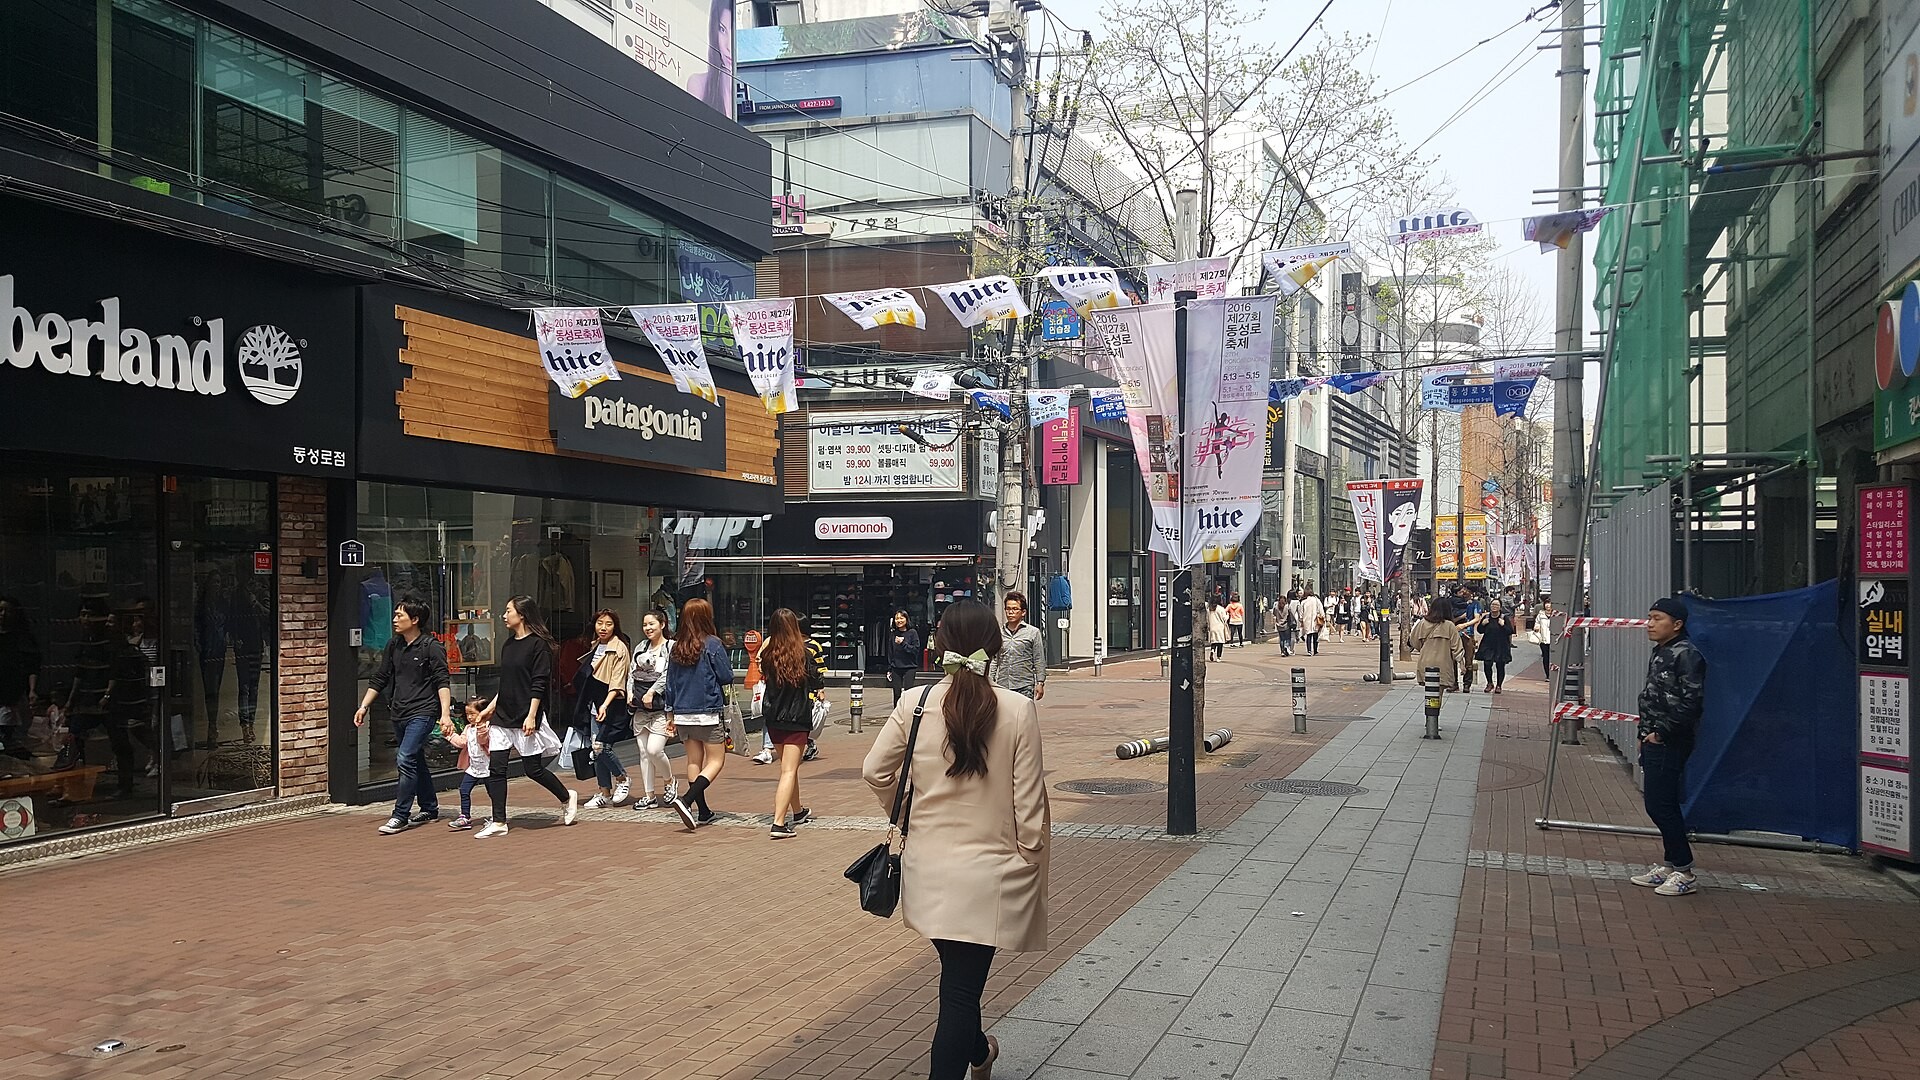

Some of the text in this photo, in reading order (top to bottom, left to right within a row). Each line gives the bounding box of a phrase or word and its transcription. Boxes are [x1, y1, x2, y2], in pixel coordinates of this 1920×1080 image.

[634, 1, 671, 47] 리프팅
[634, 34, 682, 77] 물광주사
[1199, 269, 1227, 281] 제27회
[948, 280, 1008, 313] hite
[1227, 302, 1251, 312] 2016
[652, 314, 672, 324] 2016
[747, 311, 767, 321] 2016
[1096, 314, 1118, 324] 2016
[1227, 311, 1261, 324] 제27회
[554, 317, 599, 328] 2016 제27회
[1098, 322, 1130, 335] 제27회
[555, 329, 603, 342] 동성로축제
[1226, 323, 1262, 337] 동성로
[1225, 336, 1249, 350] 축제
[546, 349, 604, 373] hite
[738, 343, 787, 373] hite
[1508, 387, 1528, 396] DGB
[583, 395, 703, 442] patagonia
[846, 444, 871, 455] 39,900
[293, 446, 346, 467] 동성로점
[818, 458, 955, 470] 매직 59,900 볼륨매직 59,900
[843, 474, 933, 486] 밤 12시 까지 영업합니다
[1866, 490, 1904, 500] 메이크업
[1866, 500, 1904, 510] 헤어미용
[1197, 505, 1244, 530] hite
[831, 520, 888, 534] viamonoh
[1866, 520, 1903, 529] 스타일리스트
[1866, 530, 1903, 539] 네일아트
[1866, 540, 1903, 549] 피부미용
[347, 552, 358, 563] 11
[1866, 550, 1903, 559] 모델양성
[1866, 609, 1903, 634] 실내
[1866, 634, 1903, 660] 암벽
[1870, 735, 1901, 747] 창업교육
